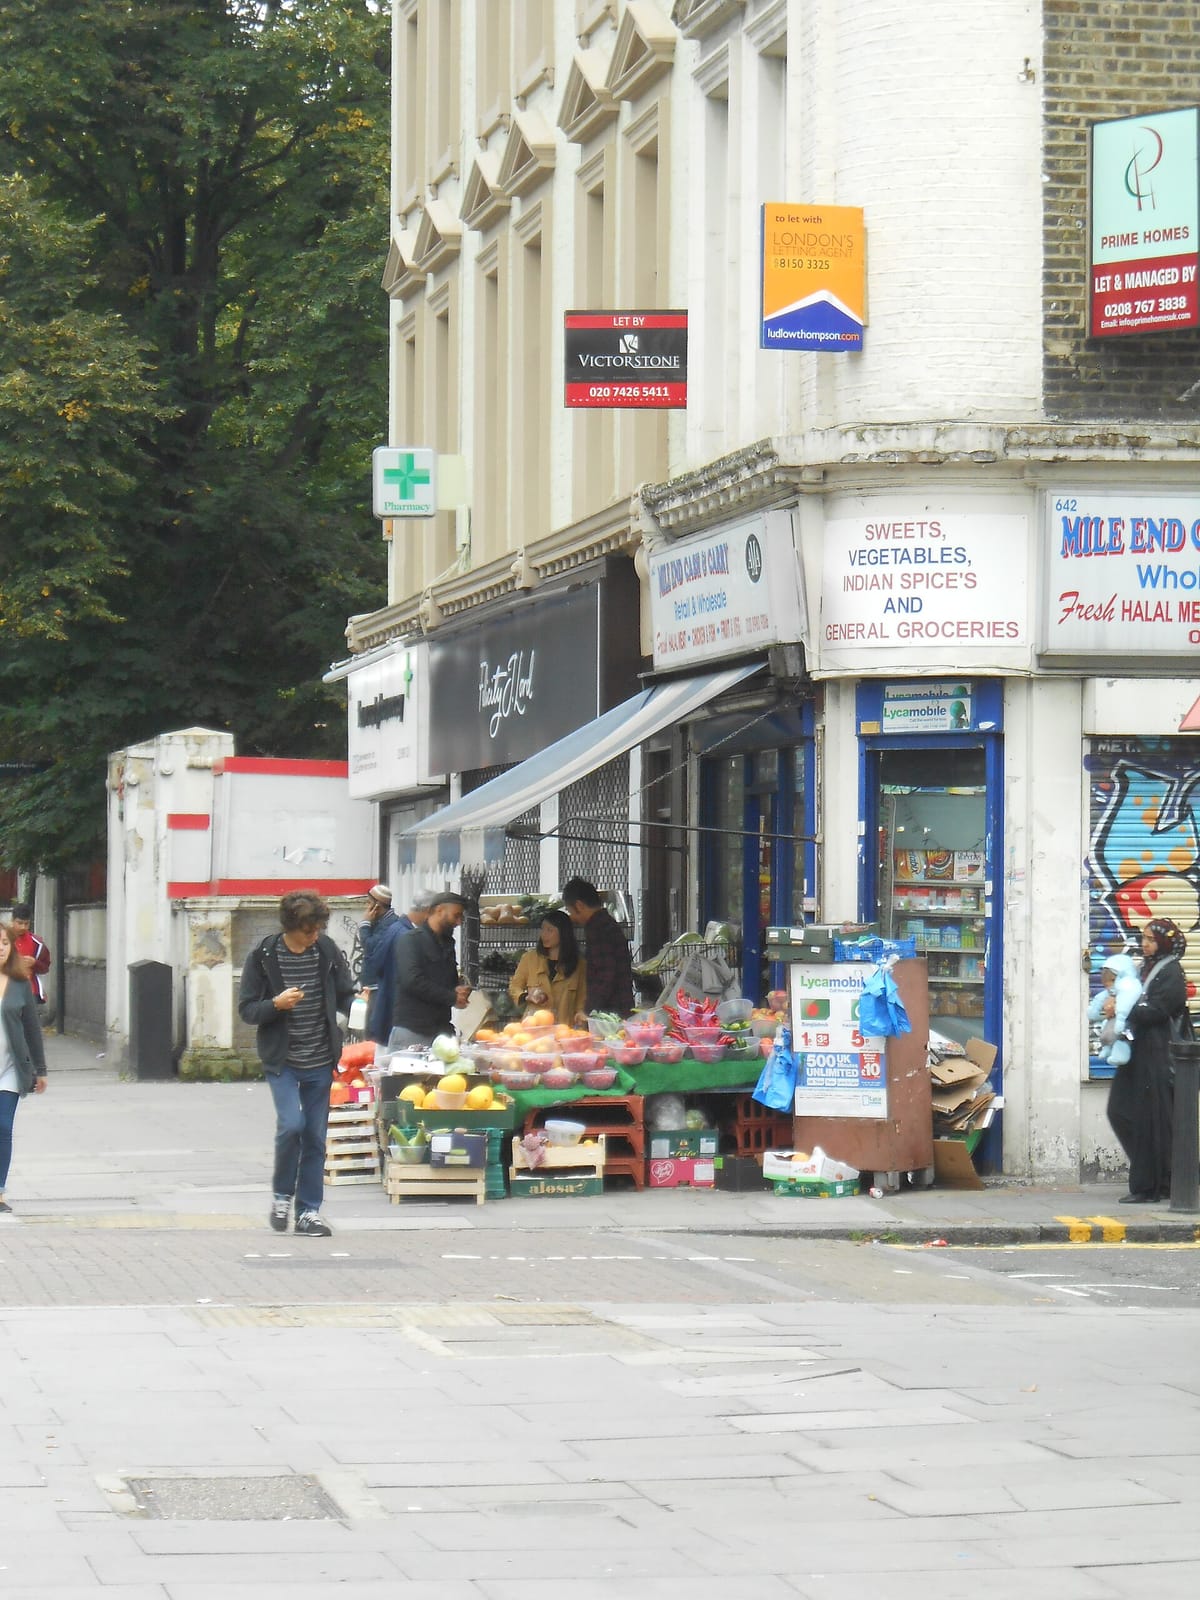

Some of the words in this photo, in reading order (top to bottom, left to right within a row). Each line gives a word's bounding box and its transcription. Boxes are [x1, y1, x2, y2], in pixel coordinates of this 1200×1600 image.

[775, 215, 785, 223] to
[787, 215, 800, 223] let
[803, 215, 823, 224] with
[773, 232, 854, 248] LONDON'S
[1101, 232, 1139, 249] PRIME
[1143, 226, 1190, 244] HOMES
[773, 246, 817, 257] LETTING
[820, 248, 853, 258] AGENT
[779, 258, 804, 269] 8150
[807, 259, 830, 270] 3325
[1094, 275, 1111, 293] LET
[1114, 274, 1122, 290] &
[1124, 268, 1179, 289] MANAGED
[1182, 265, 1196, 283] BY
[1104, 302, 1132, 317] 0208
[1134, 299, 1155, 314] 767
[1158, 296, 1187, 311] 3838
[613, 317, 630, 326] LET
[632, 317, 645, 326] BY
[767, 328, 860, 342] ludlowthompson.com
[589, 387, 610, 397] 020
[613, 387, 640, 397] 7426
[642, 387, 669, 397] 5411
[384, 501, 431, 513] Pharmacy
[1055, 499, 1077, 512] 642
[865, 521, 946, 541] SWEETS,
[1060, 516, 1125, 559] MILE
[1129, 517, 1187, 553] END
[848, 546, 972, 567] VEGETABLES,
[671, 558, 683, 589] END
[708, 542, 729, 575] CARRY
[843, 573, 894, 593] INDIAN
[900, 572, 977, 590] SPICE'S
[674, 597, 690, 621] Retail
[698, 588, 727, 614] Wholesale
[883, 597, 923, 614] AND
[1058, 591, 1118, 625] Fresh
[1121, 600, 1173, 623] HALAL
[825, 623, 889, 641] GENERAL
[897, 621, 1019, 639] GROCERIES
[884, 706, 947, 719] Lycamobile
[806, 1054, 836, 1068] 500
[836, 1054, 851, 1063] UK
[806, 1067, 859, 1078] UNLIMITED
[861, 1062, 881, 1077] £10
